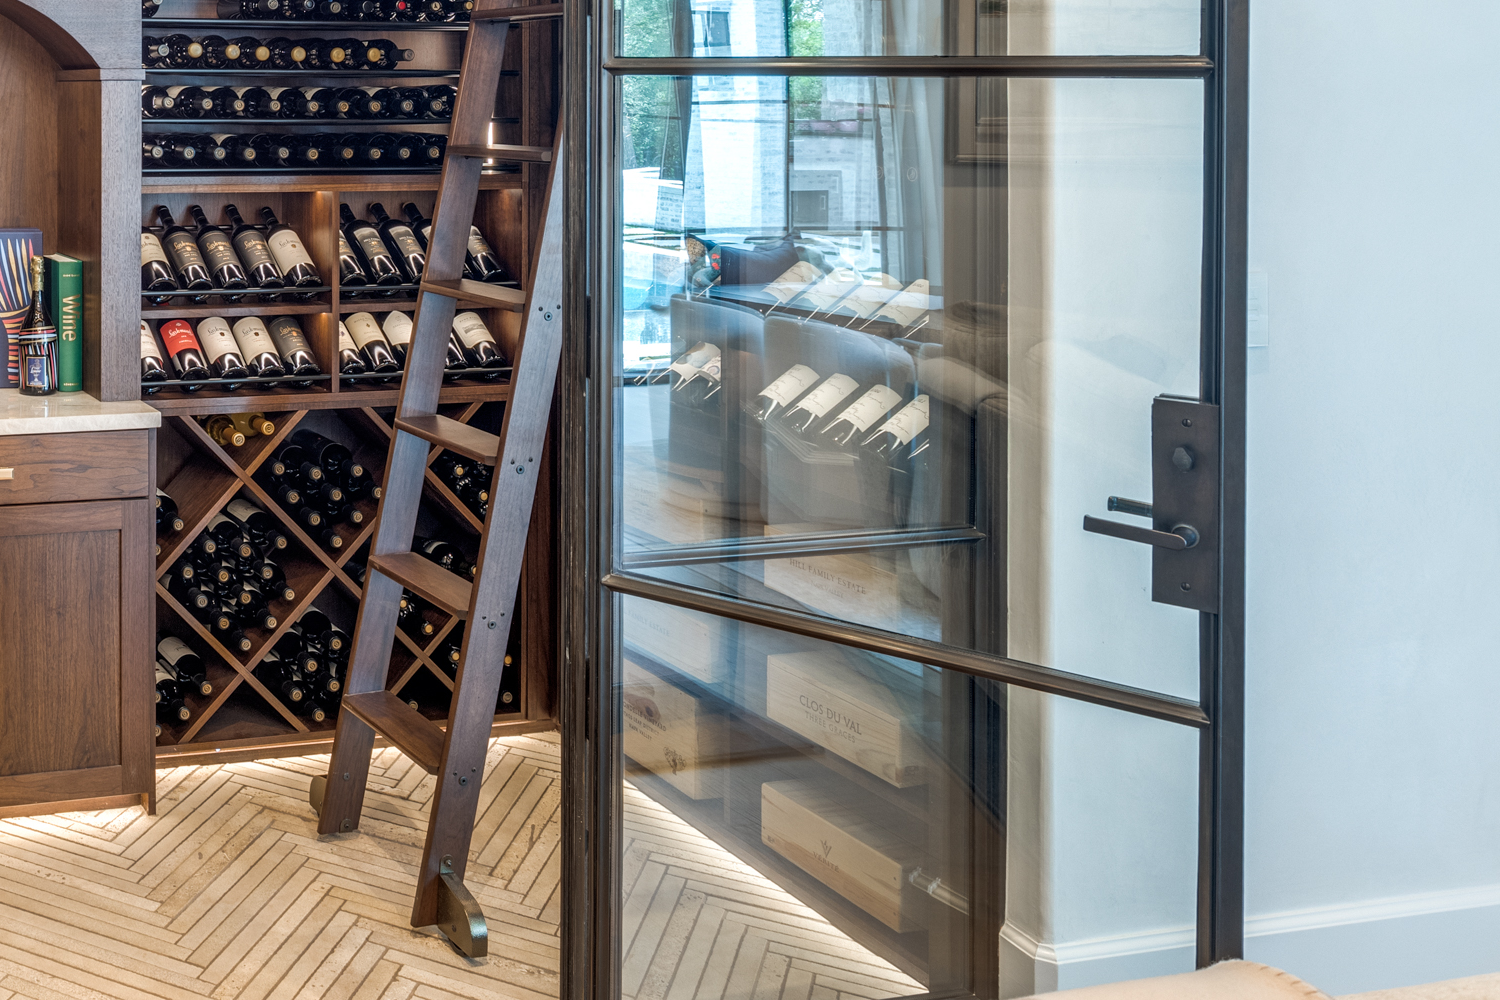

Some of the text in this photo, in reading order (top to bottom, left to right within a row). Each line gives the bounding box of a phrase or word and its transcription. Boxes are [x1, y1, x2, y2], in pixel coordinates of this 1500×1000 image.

[62, 294, 81, 342] Wine
[624, 701, 643, 718] ONDELLE
[799, 695, 862, 736] CLOS DU VAL
[805, 710, 856, 744] THREE GRACES
